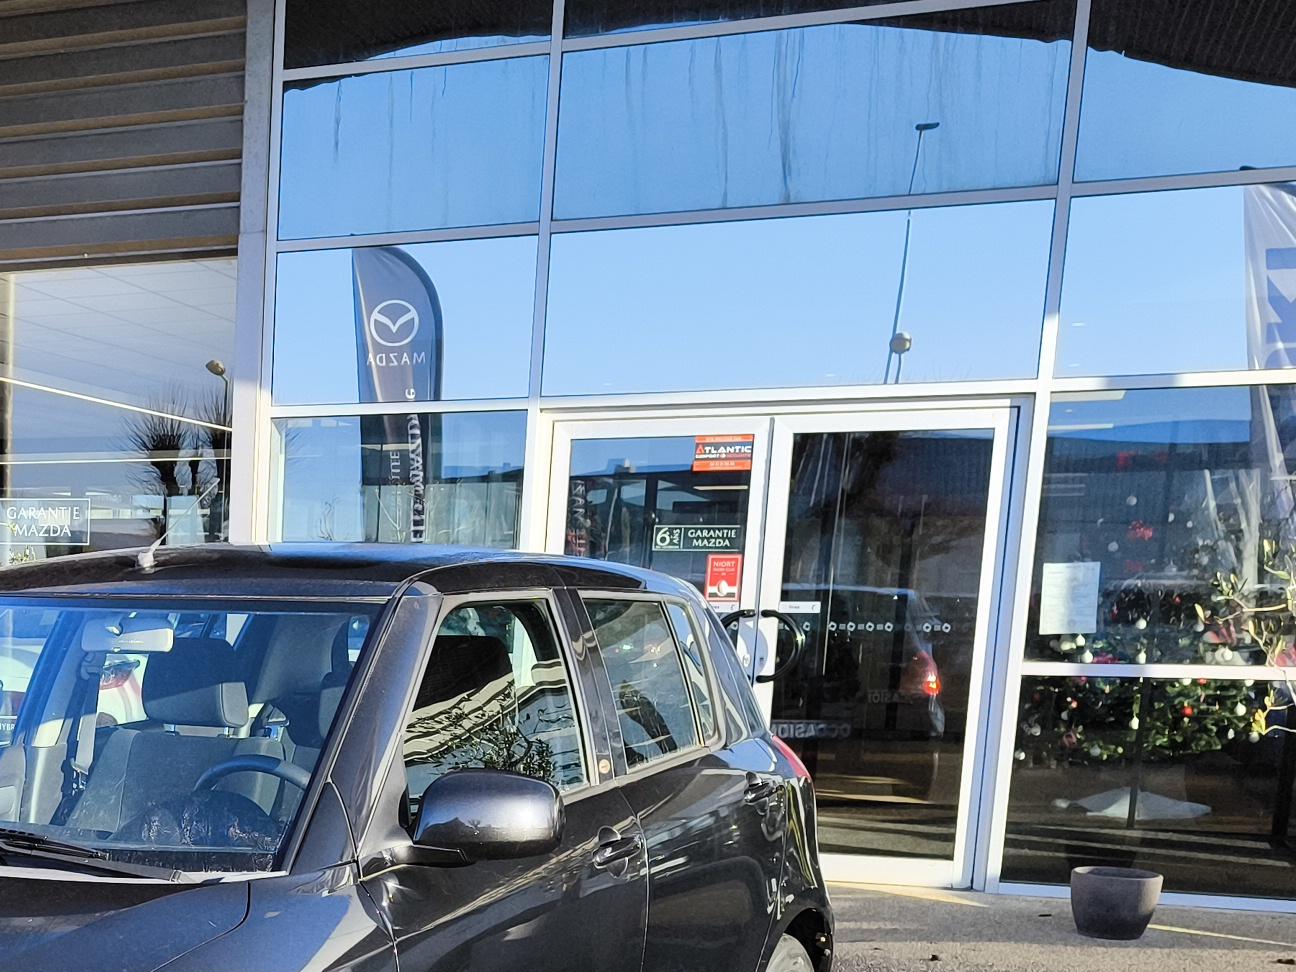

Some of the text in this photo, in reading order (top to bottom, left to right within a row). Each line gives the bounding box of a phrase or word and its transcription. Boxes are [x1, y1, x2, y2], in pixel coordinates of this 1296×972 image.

[696, 444, 752, 454] ATLANTIC
[6, 507, 80, 519] GARANTIE
[14, 525, 71, 536] MAZDA
[688, 530, 736, 538] GARANTIE
[656, 528, 670, 546] 6
[692, 539, 730, 547] MAZDA
